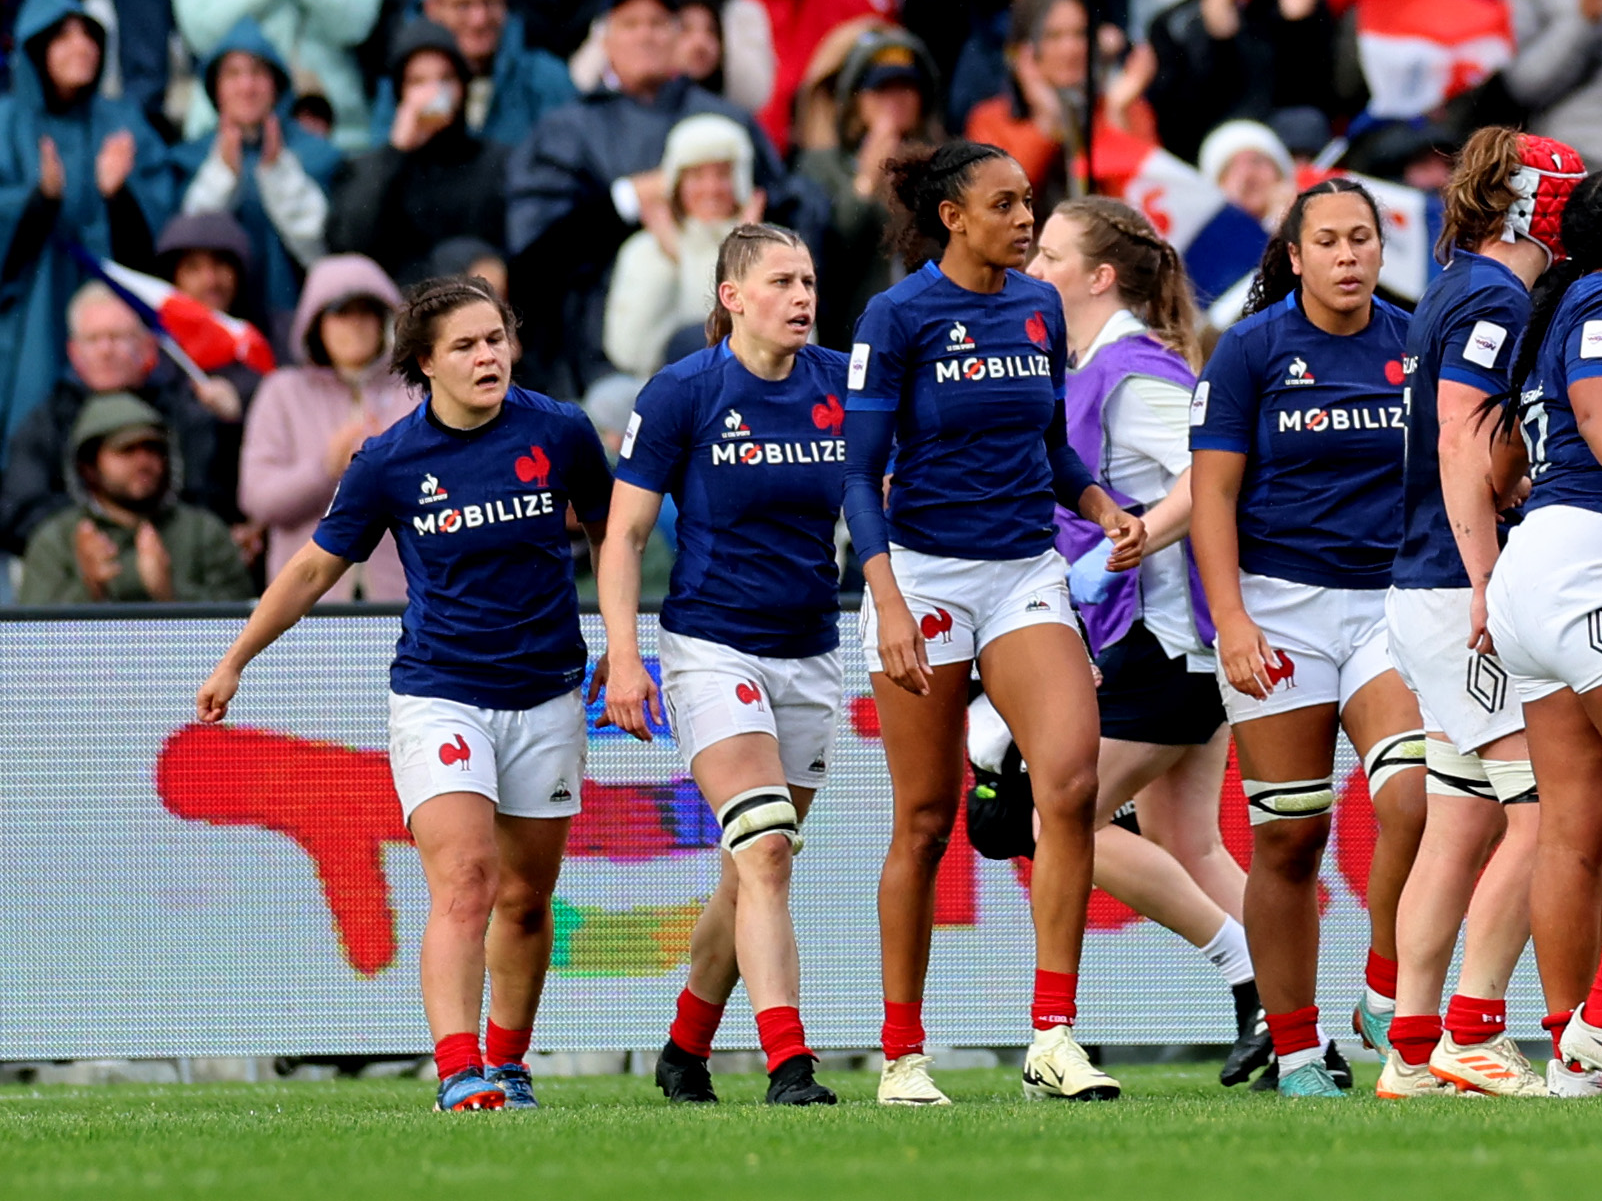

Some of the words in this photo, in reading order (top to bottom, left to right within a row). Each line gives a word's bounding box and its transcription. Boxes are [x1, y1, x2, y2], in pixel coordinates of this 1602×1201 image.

[1279, 407, 1405, 433] MOBILIZ
[711, 440, 846, 466] MOBILIZE
[412, 491, 554, 536] MOBILIZE
